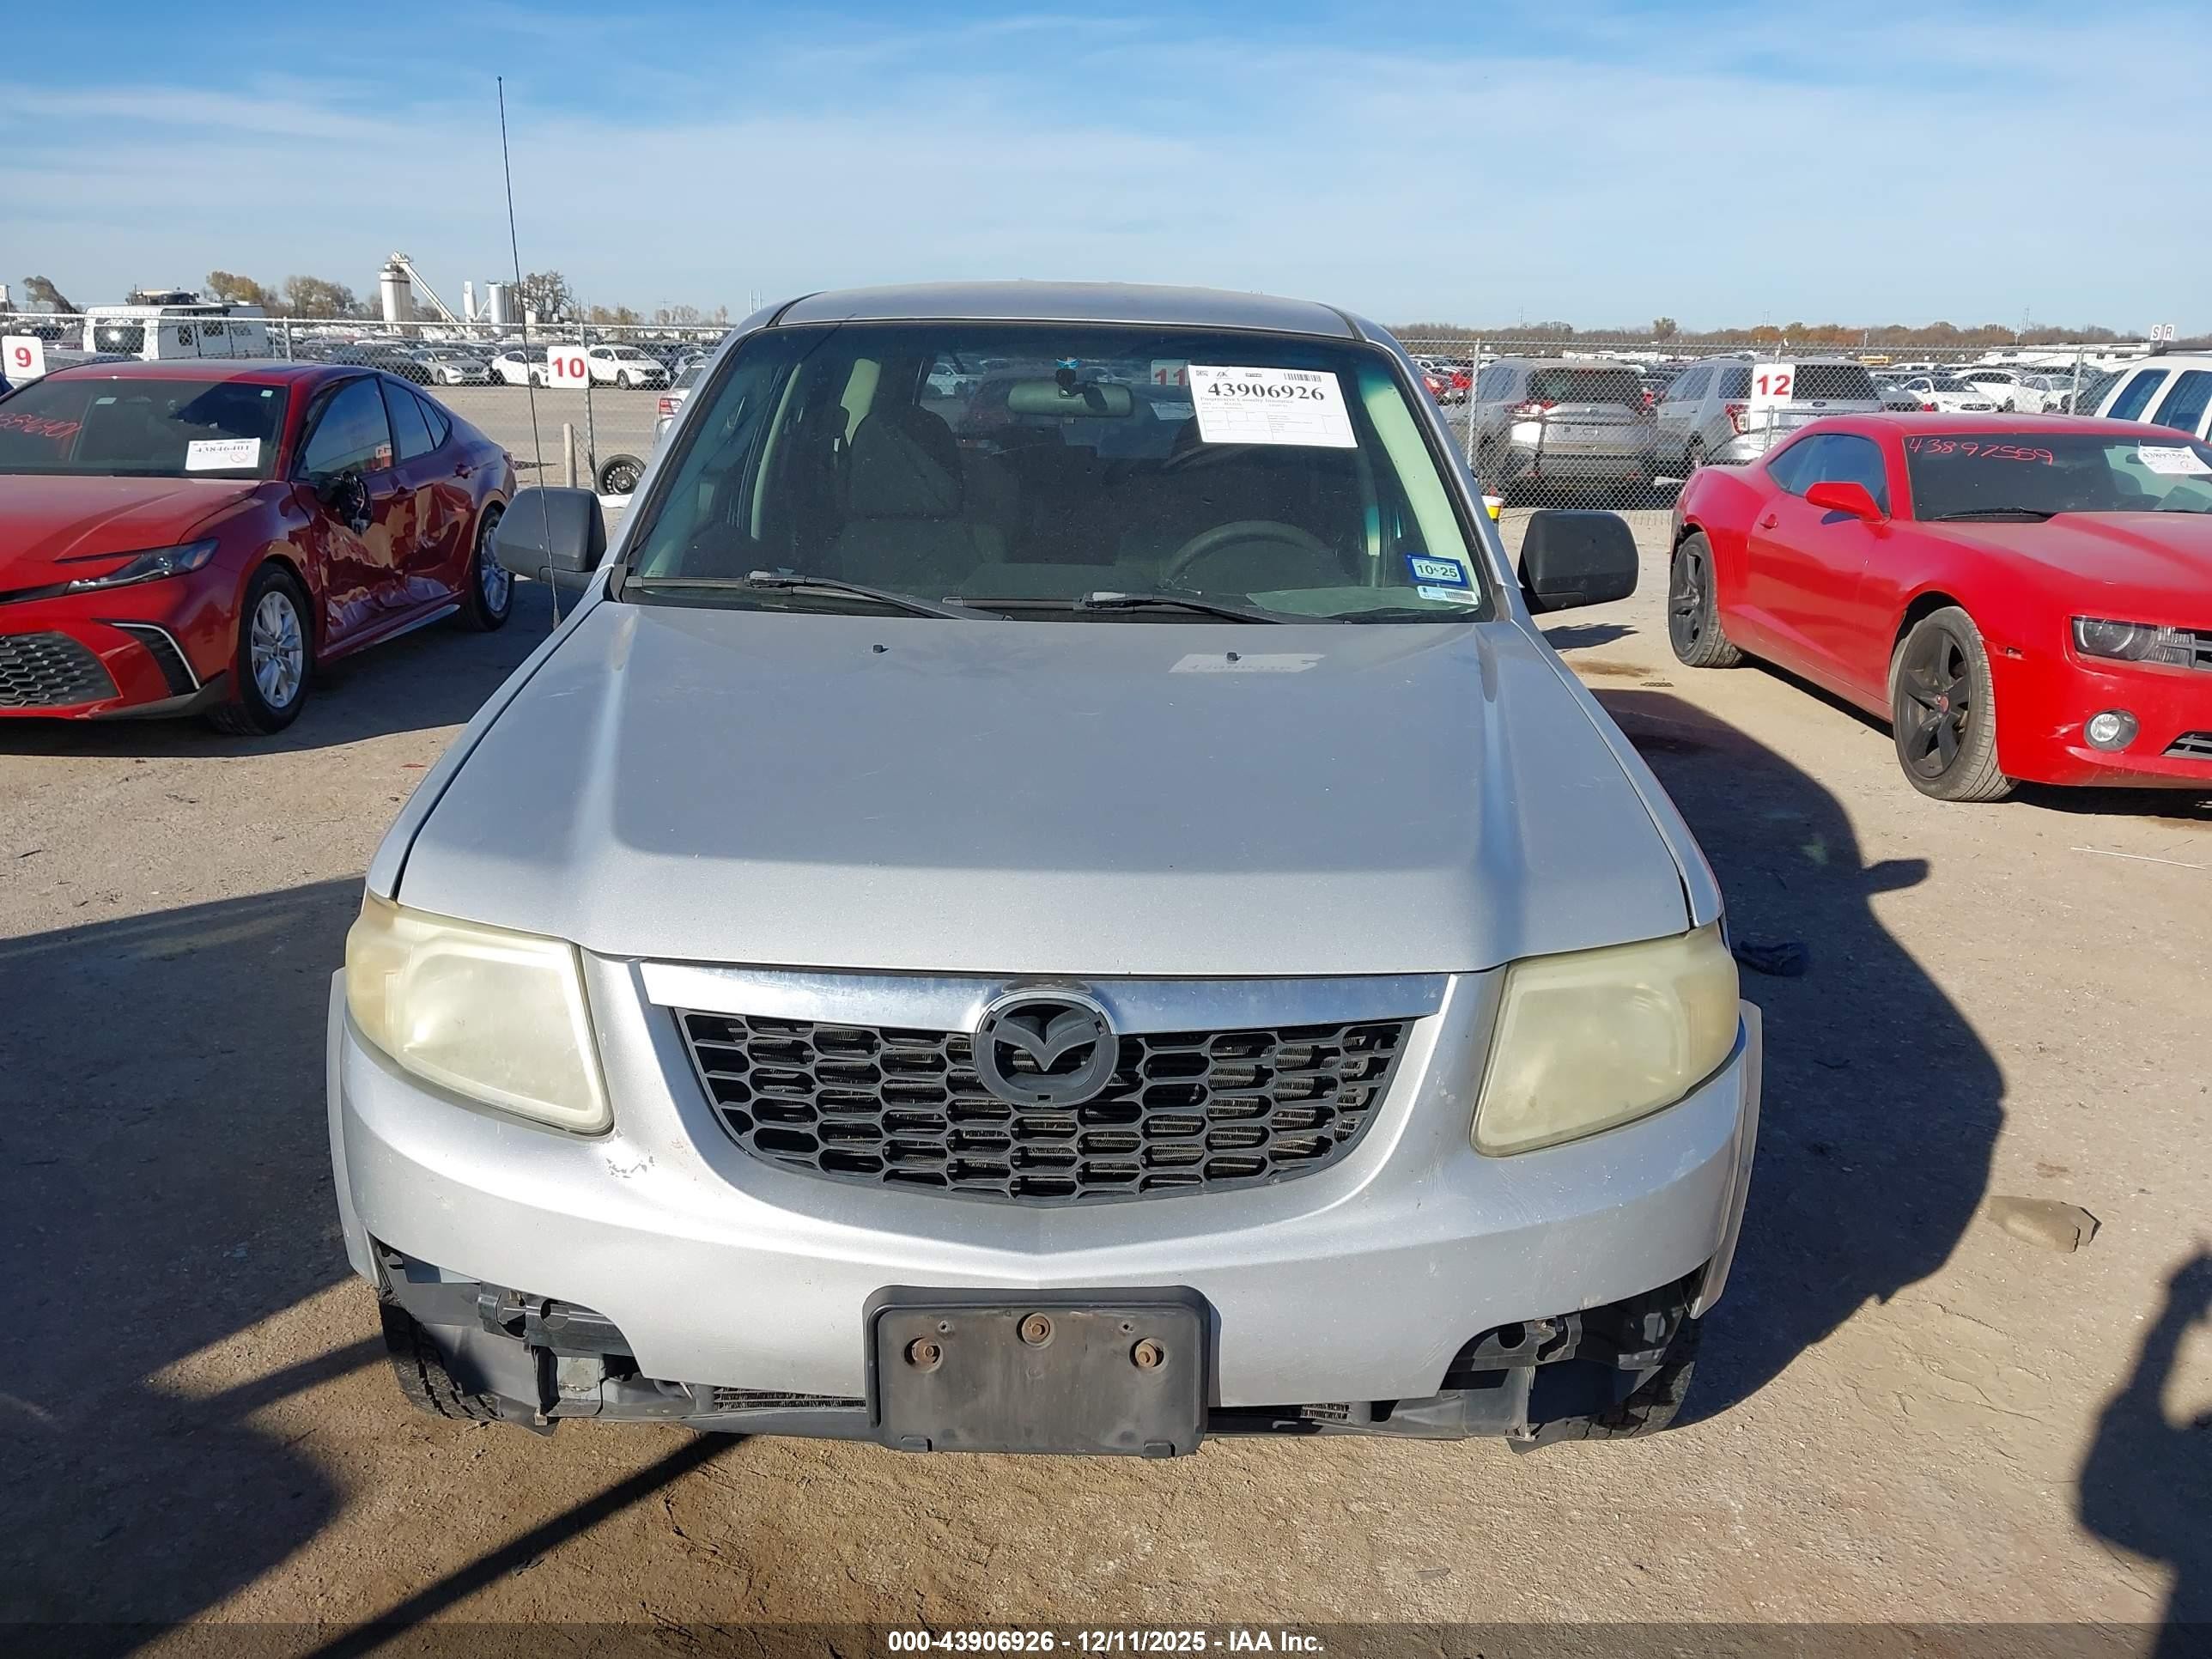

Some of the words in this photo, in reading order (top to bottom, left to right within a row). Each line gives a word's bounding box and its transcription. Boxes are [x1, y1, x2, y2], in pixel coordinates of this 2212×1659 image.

[2153, 326, 2160, 339] S
[2165, 325, 2172, 338] R
[15, 347, 32, 368] 9
[552, 357, 585, 378] 10
[1154, 368, 1185, 385] 11
[1757, 374, 1791, 395] 12
[1207, 382, 1325, 401] 43906926
